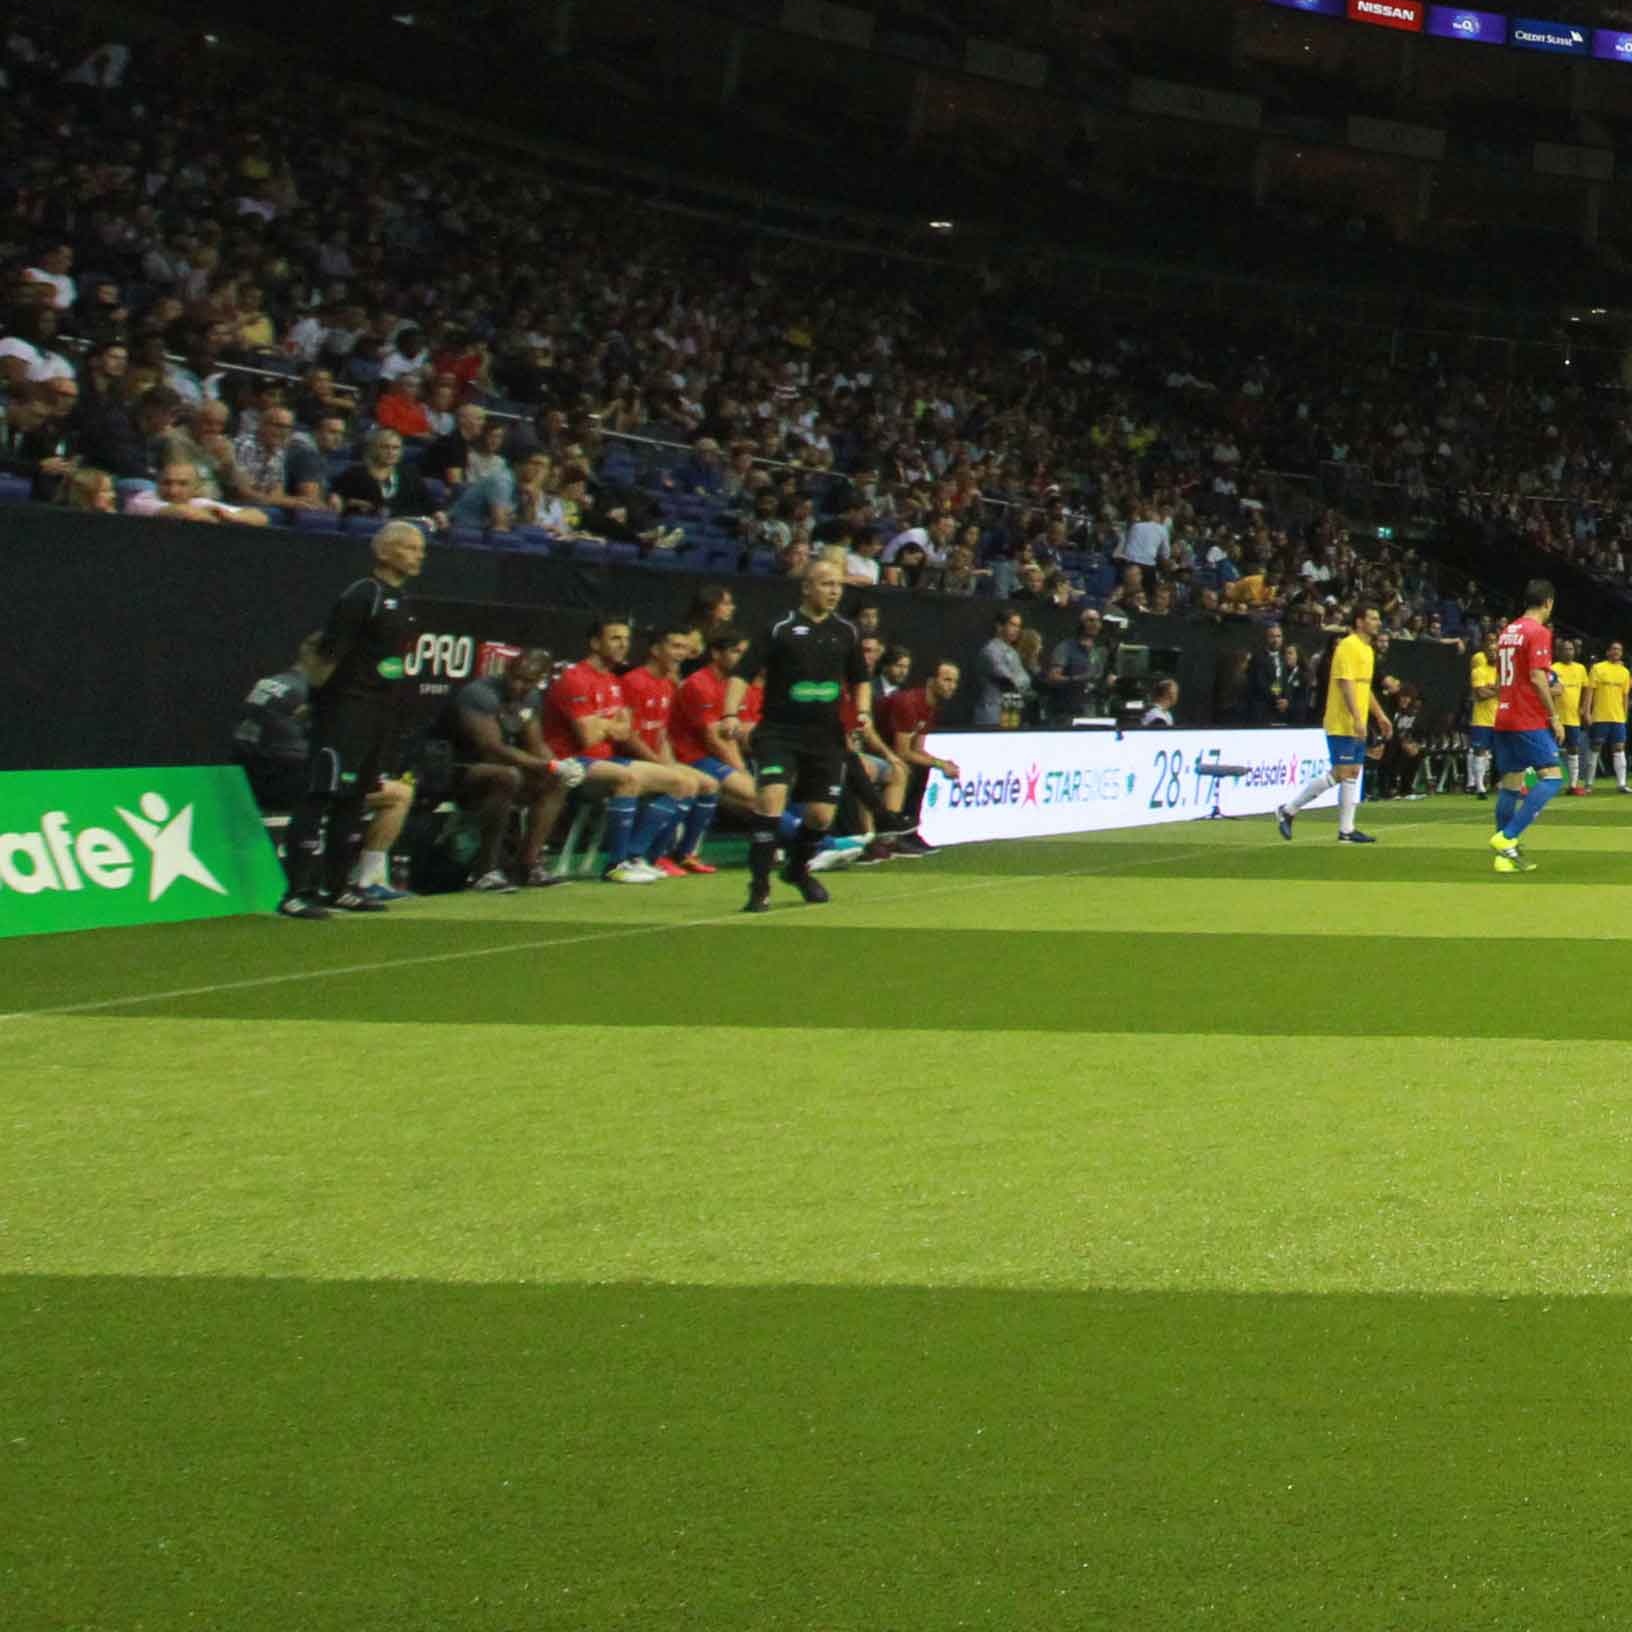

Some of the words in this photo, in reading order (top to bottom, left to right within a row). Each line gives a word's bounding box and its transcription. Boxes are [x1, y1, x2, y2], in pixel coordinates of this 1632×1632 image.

[1357, 0, 1415, 22] NISSAN
[1498, 647, 1517, 687] 15
[948, 769, 1021, 808] betsafe
[1148, 748, 1221, 809] 28:17
[0, 810, 135, 895] afe
